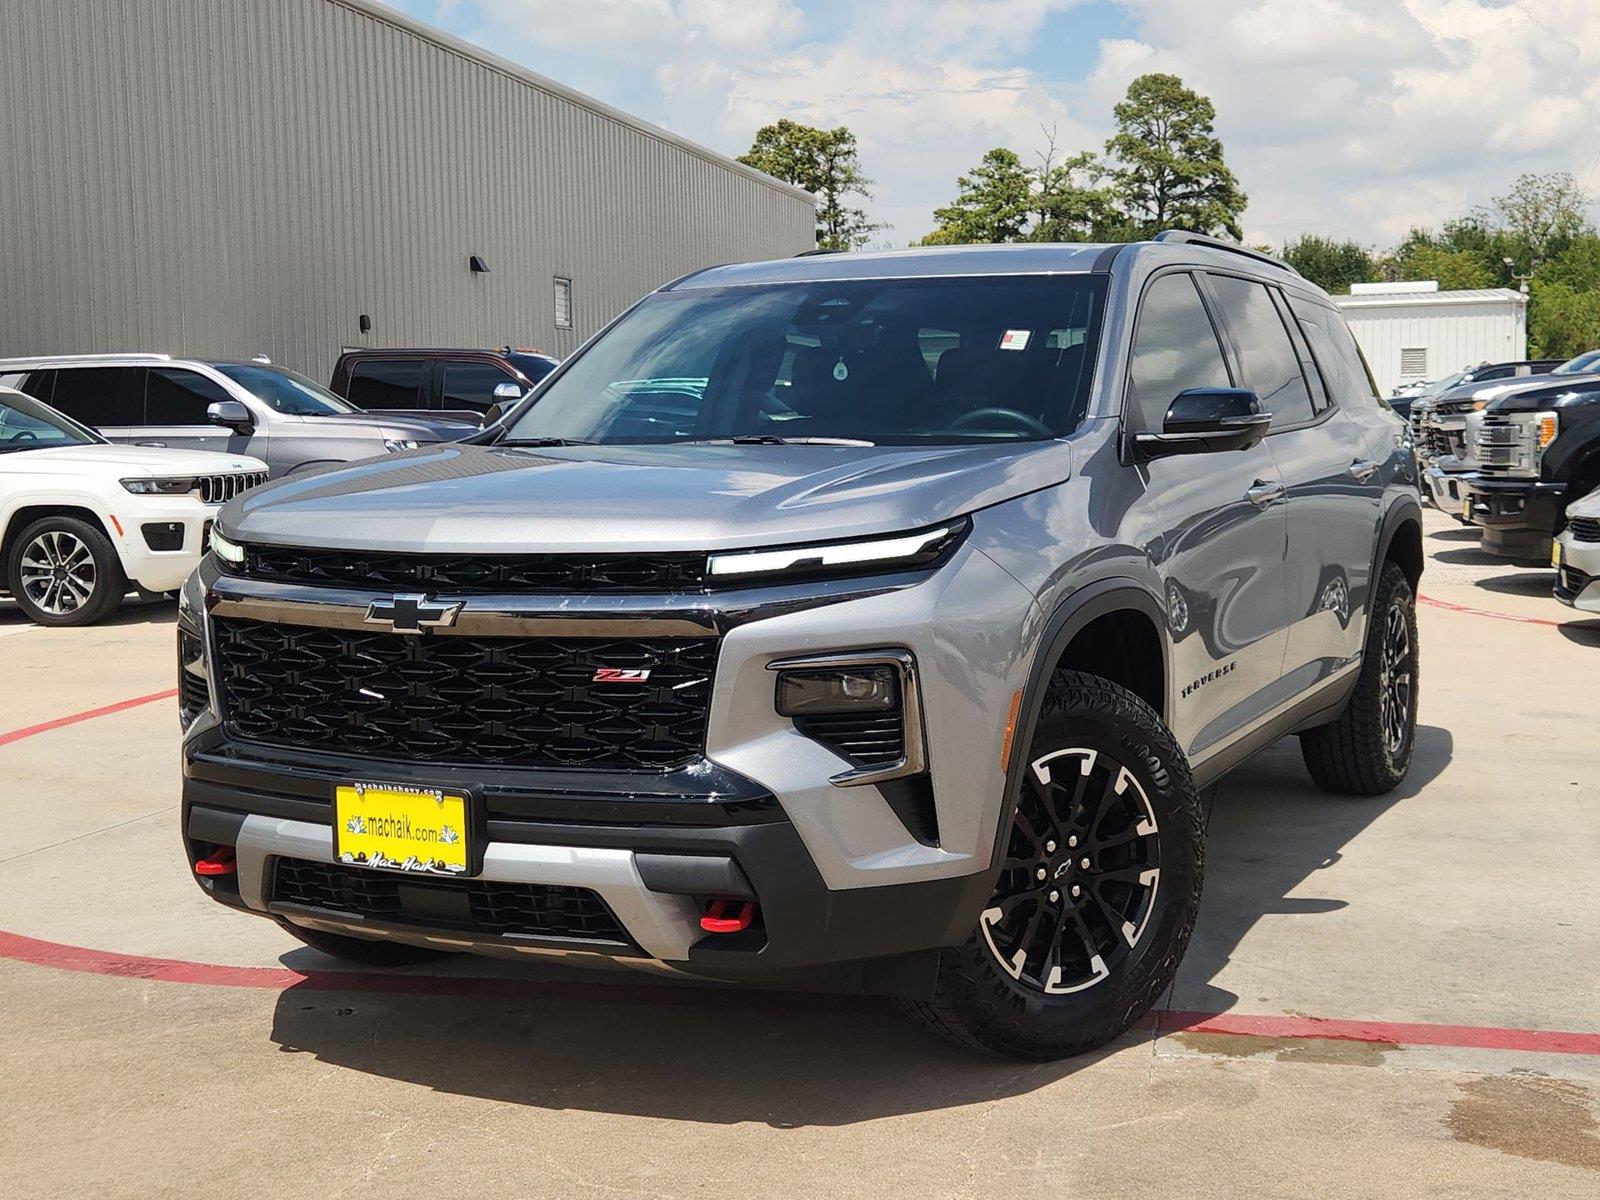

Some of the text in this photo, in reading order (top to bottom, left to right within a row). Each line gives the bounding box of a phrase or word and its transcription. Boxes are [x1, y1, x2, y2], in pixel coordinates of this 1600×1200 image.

[592, 668, 651, 683] Z71
[1181, 661, 1237, 699] TRAVERSE
[354, 782, 443, 797] machaikchevy.com
[367, 813, 438, 843] machaik.com
[367, 851, 453, 875] Mac Haik
